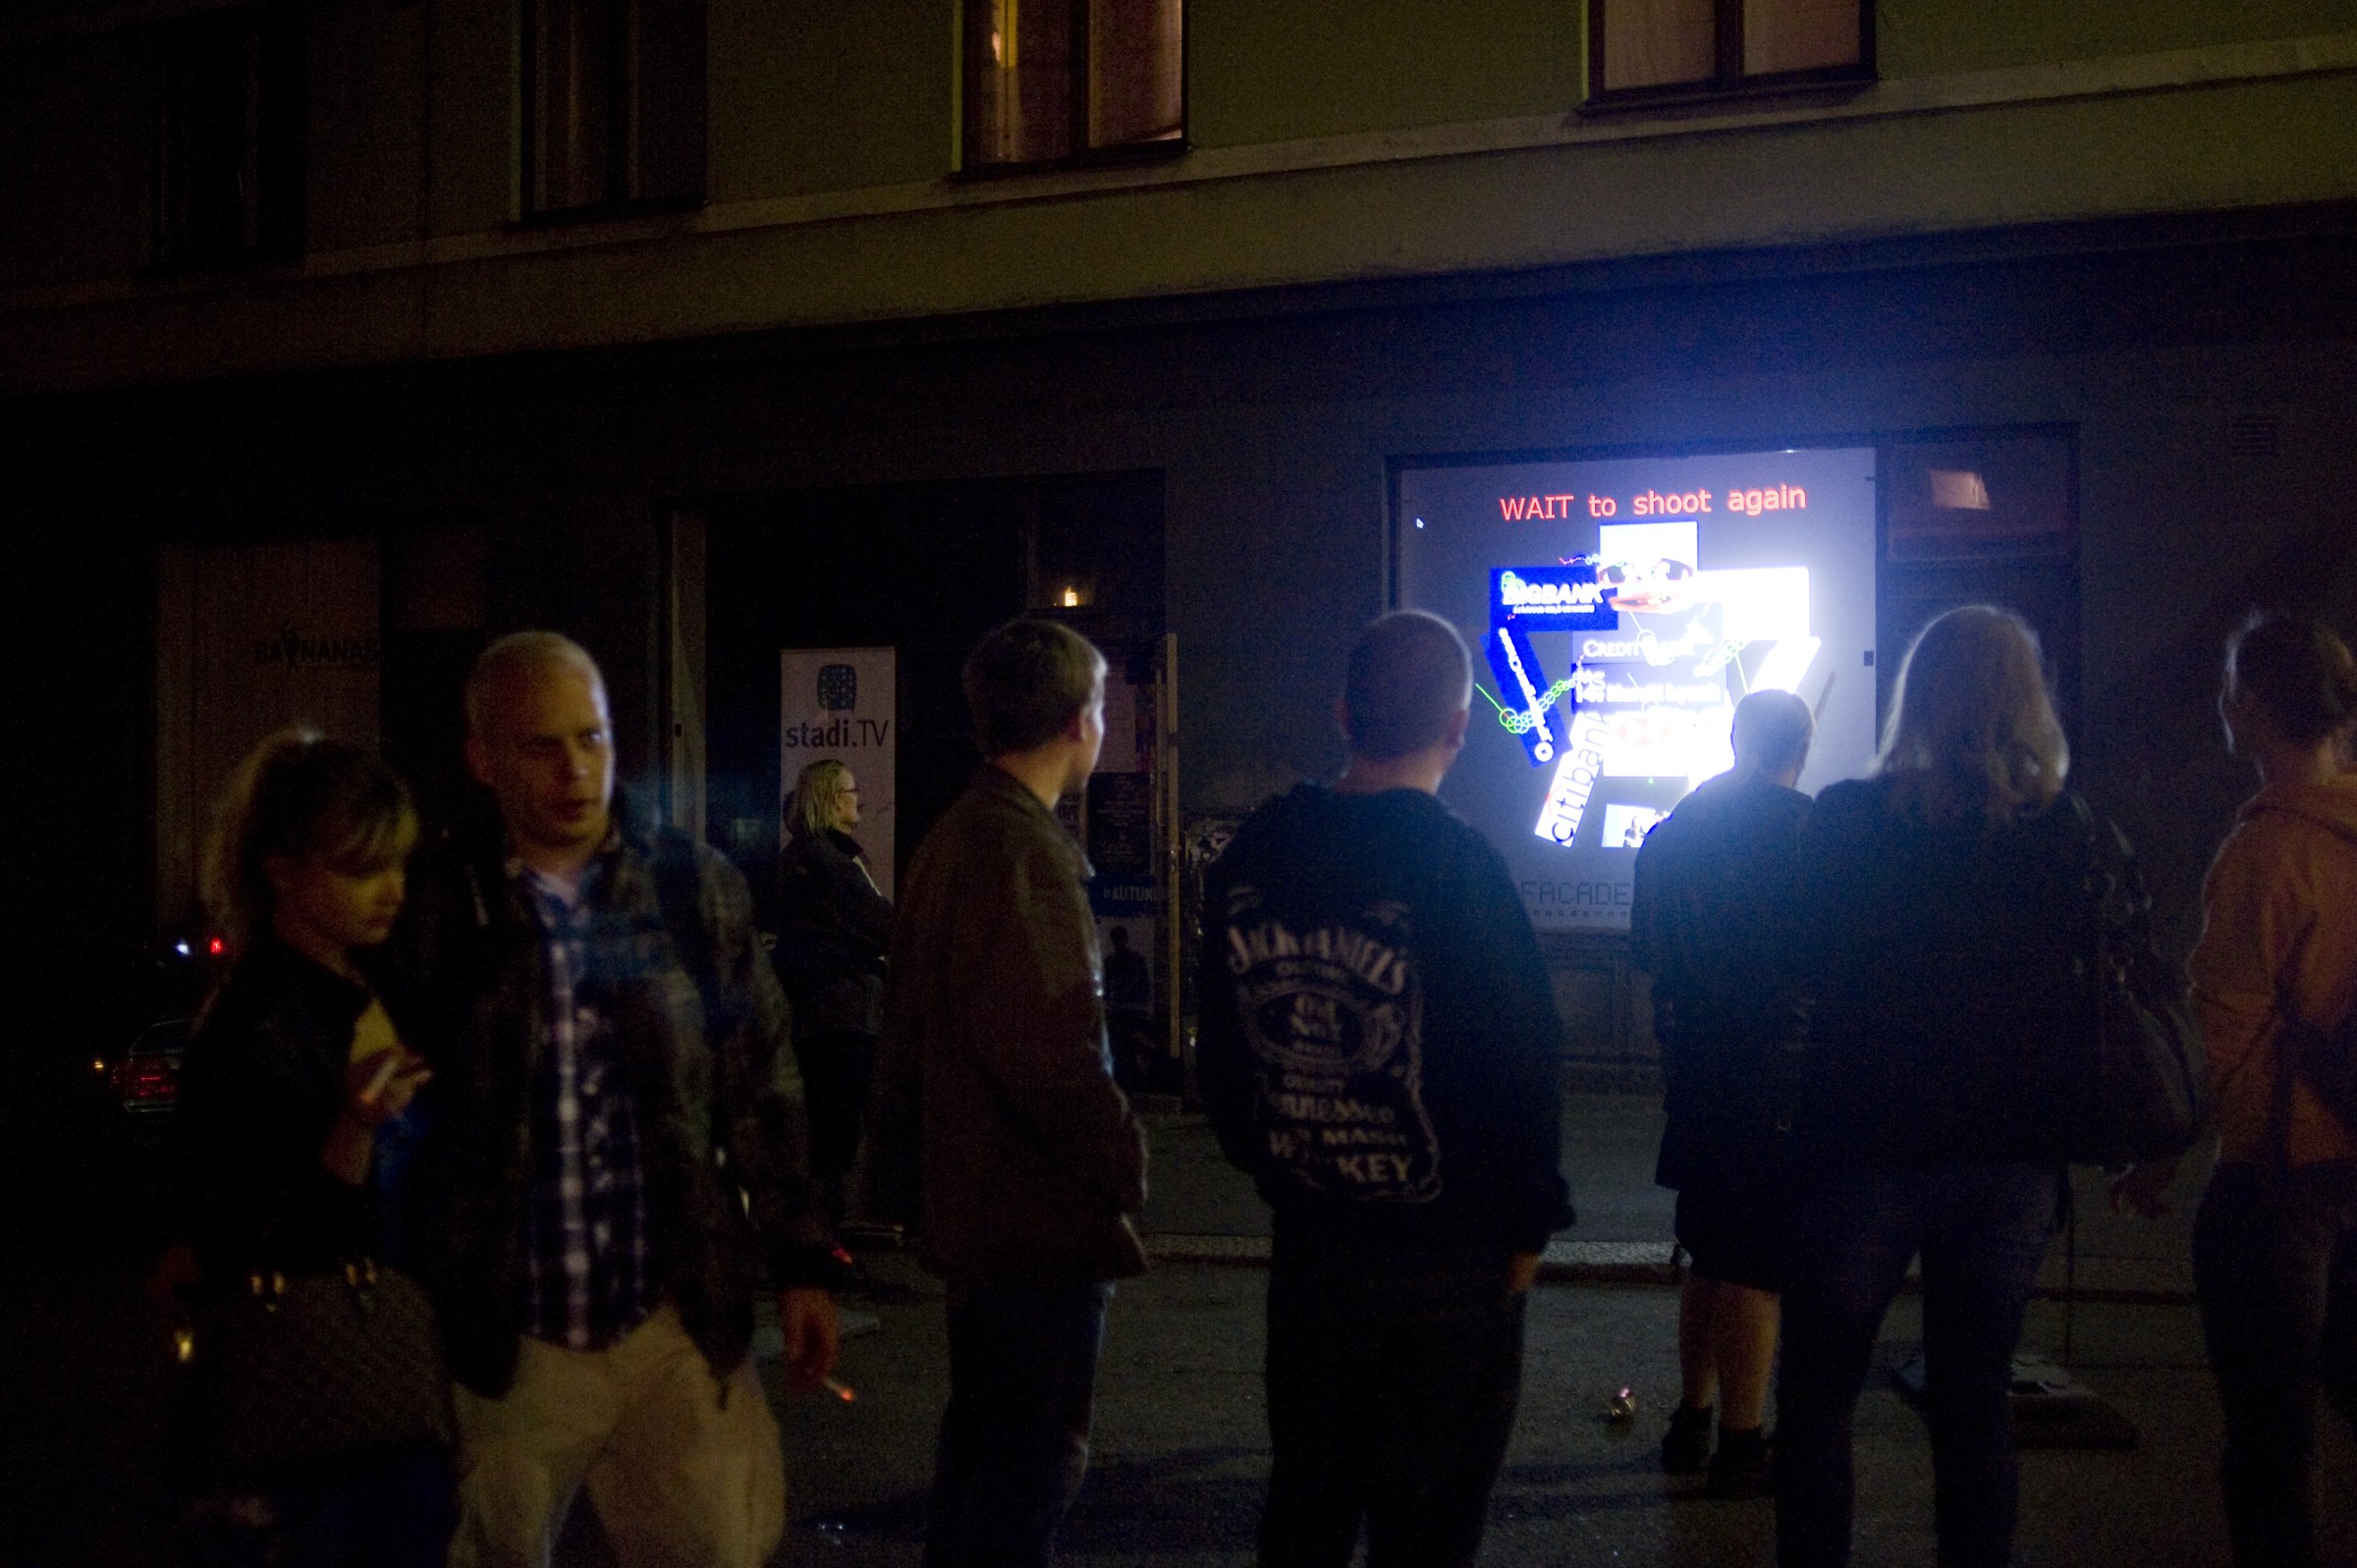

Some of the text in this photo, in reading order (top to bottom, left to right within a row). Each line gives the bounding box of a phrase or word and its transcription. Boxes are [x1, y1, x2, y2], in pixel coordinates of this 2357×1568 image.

[1500, 483, 1806, 521] WAIT to shoot again
[786, 719, 889, 748] stadi.TV
